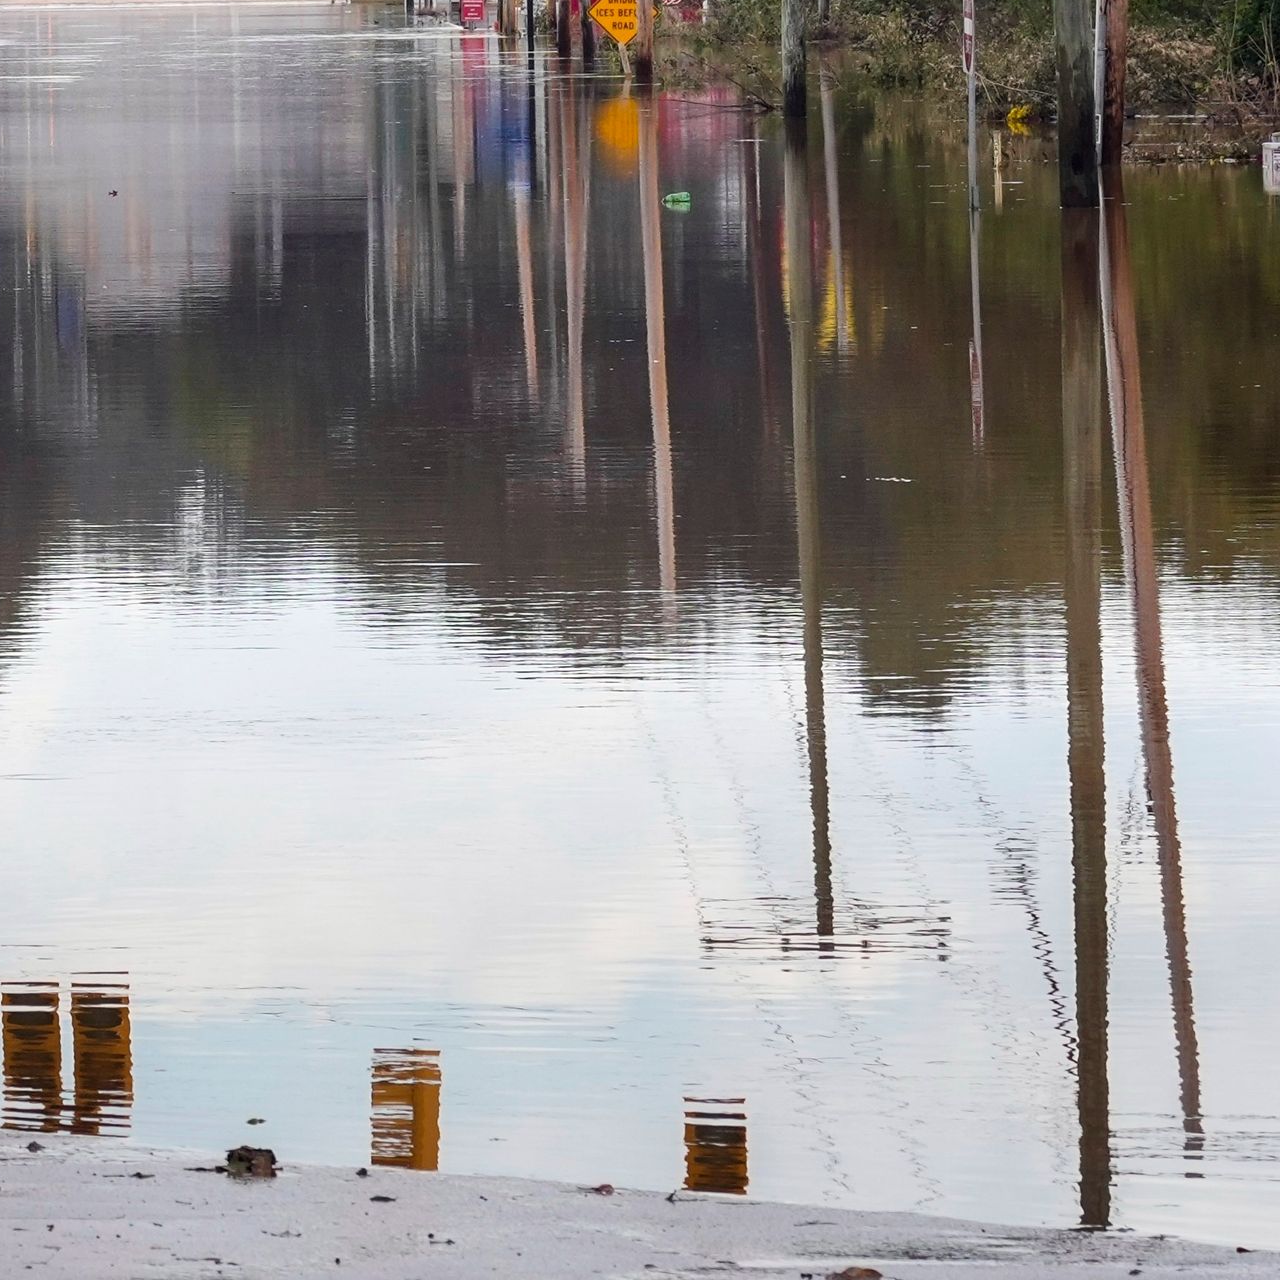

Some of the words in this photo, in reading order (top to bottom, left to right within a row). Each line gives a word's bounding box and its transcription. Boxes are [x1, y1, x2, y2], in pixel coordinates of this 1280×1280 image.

[596, 9, 615, 17] ICES
[618, 9, 637, 17] BEF
[612, 22, 634, 30] ROAD
